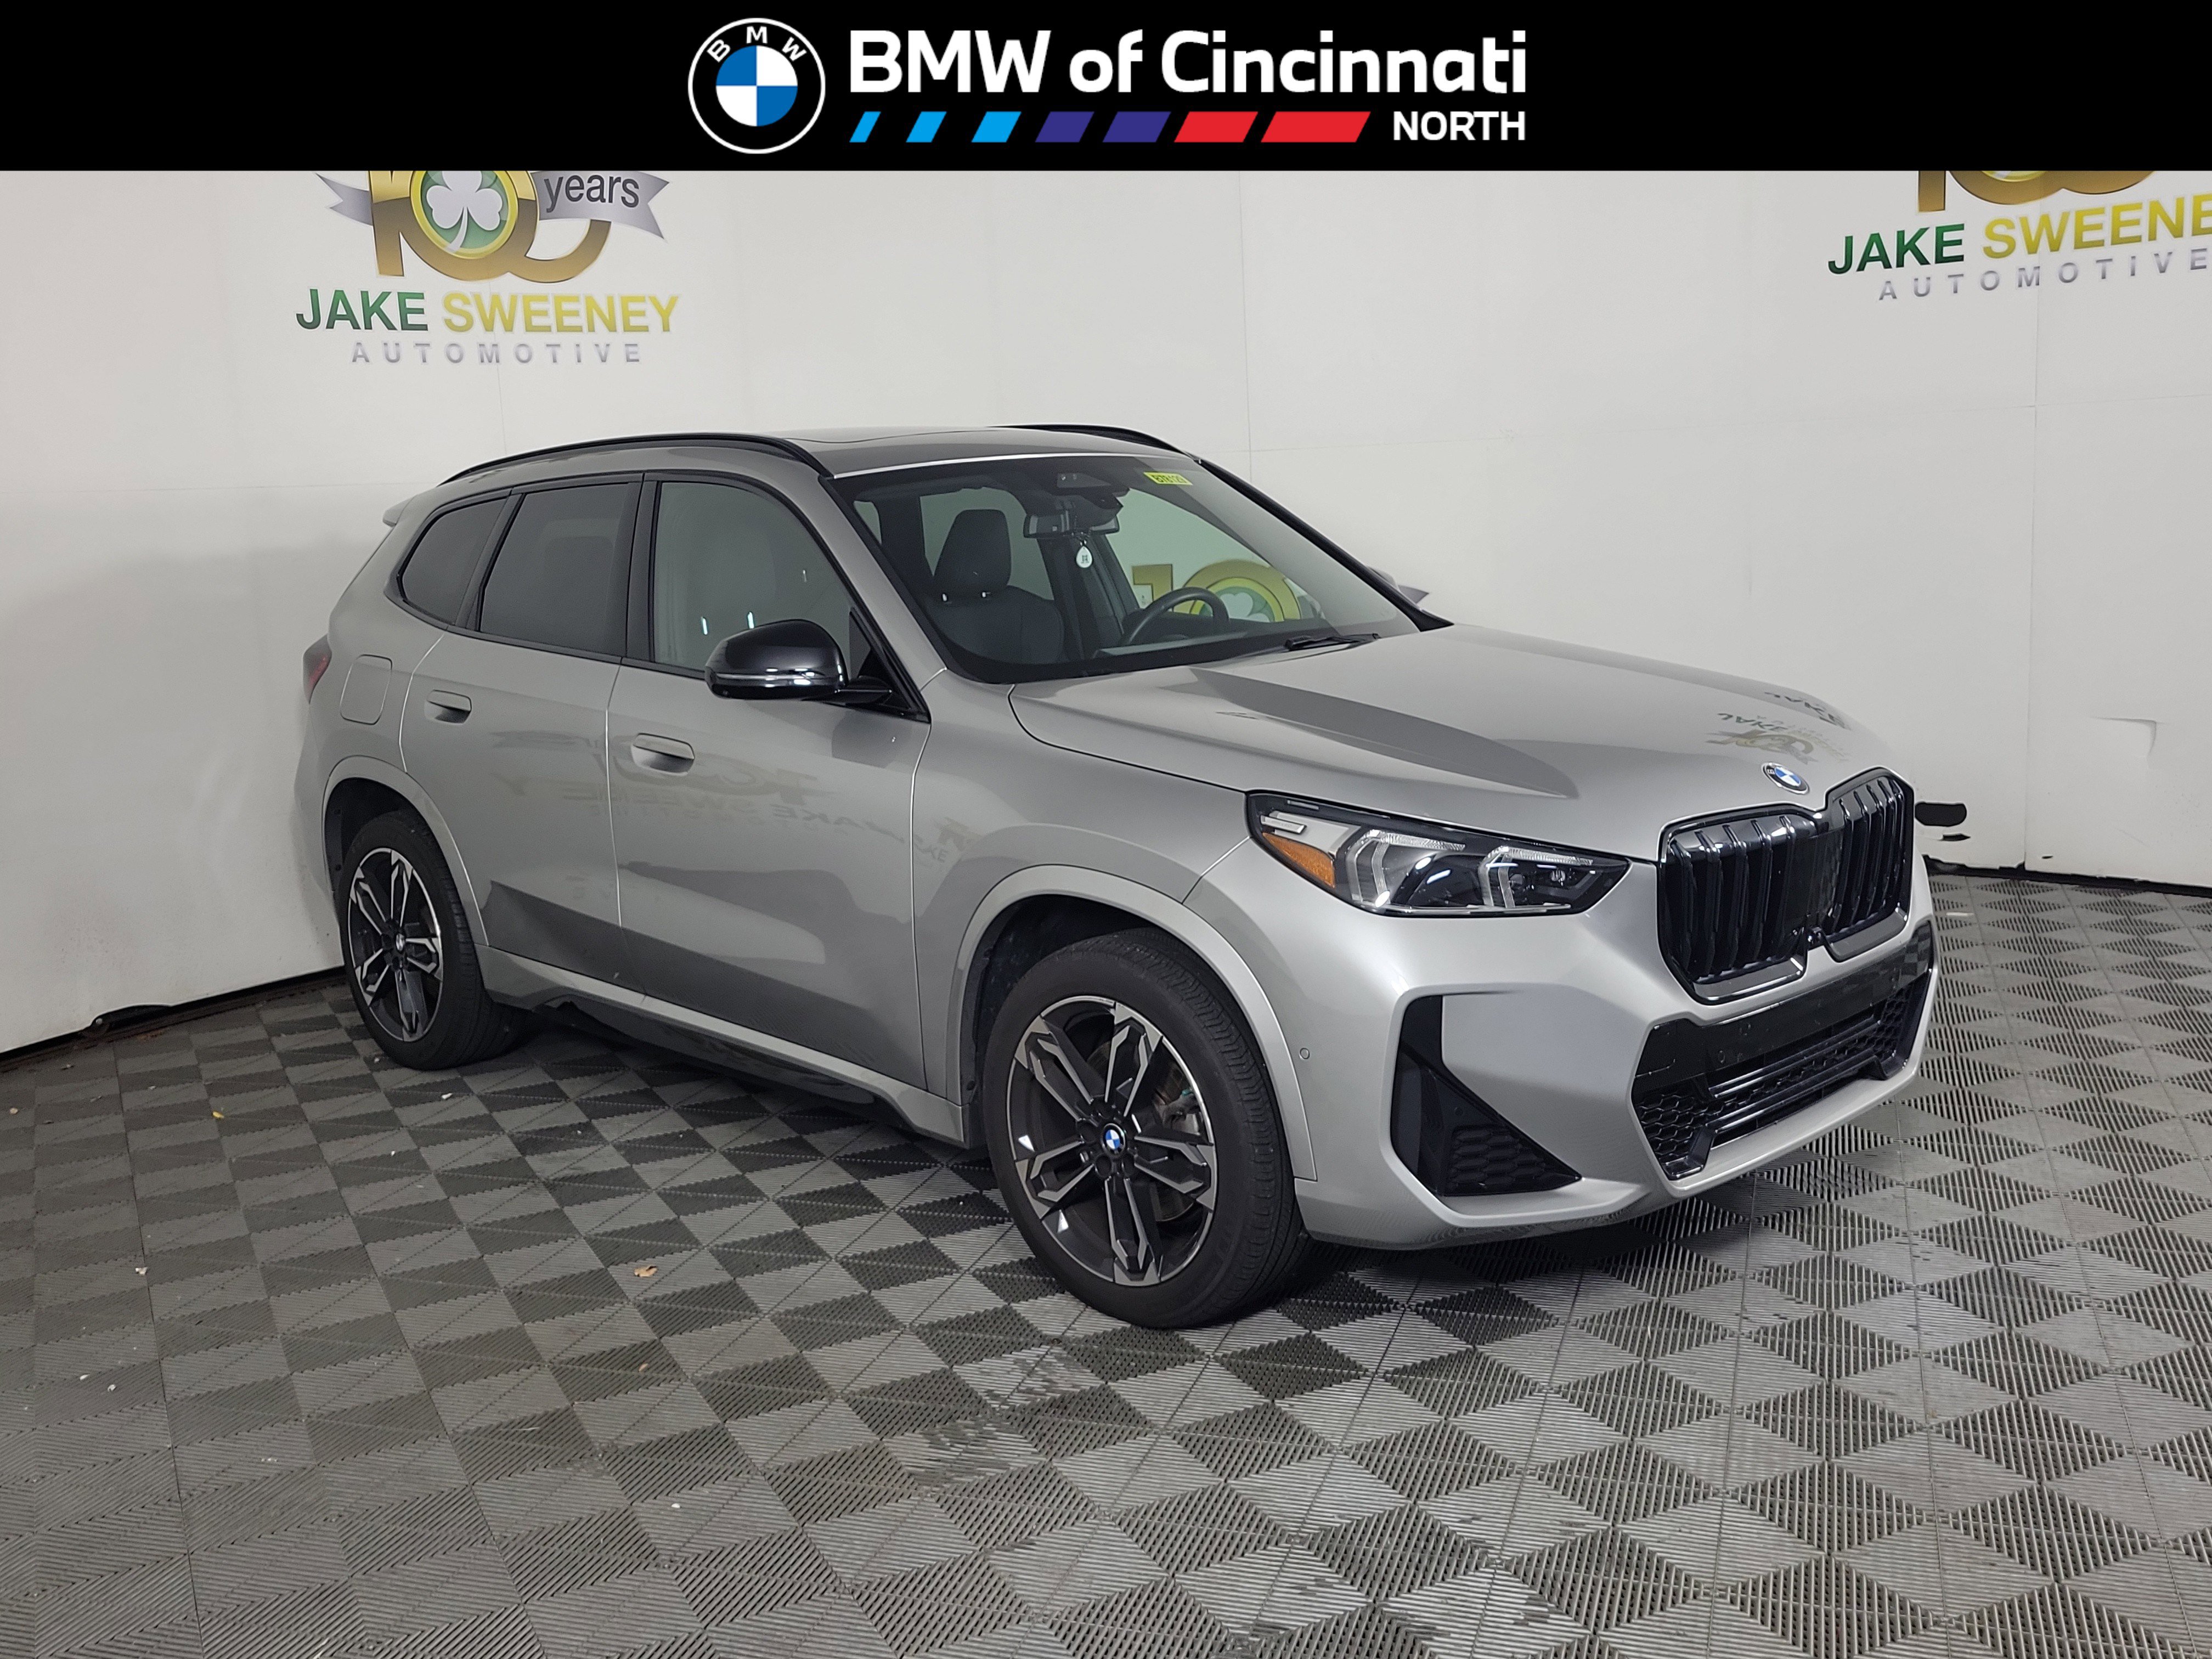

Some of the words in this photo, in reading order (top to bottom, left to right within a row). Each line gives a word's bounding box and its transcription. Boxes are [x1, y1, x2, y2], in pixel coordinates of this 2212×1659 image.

[544, 174, 640, 214] years
[1828, 223, 1965, 275] JAKE
[1983, 193, 2212, 259] SWEENE
[1878, 248, 2208, 301] AUTOMOTIVE
[296, 289, 428, 331] JAKE
[443, 292, 679, 332] SWEENEY
[352, 342, 640, 364] AUTOMOTIVE
